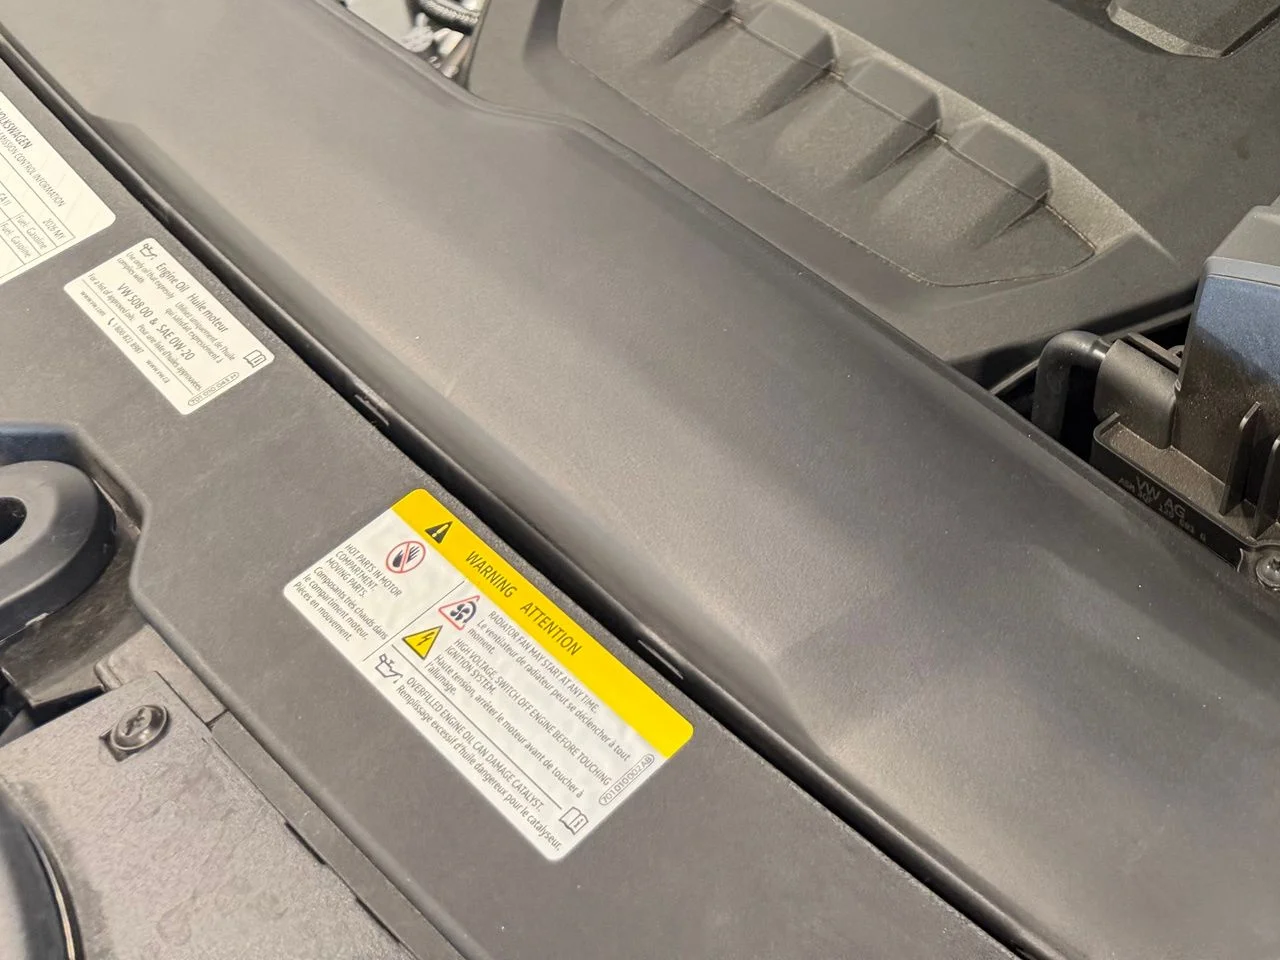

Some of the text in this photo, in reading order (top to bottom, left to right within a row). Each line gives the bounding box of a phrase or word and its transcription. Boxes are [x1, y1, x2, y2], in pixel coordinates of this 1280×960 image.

[155, 263, 190, 292] Engine Oil
[117, 283, 195, 360] VW 508 00 & SAE 0W-20
[187, 293, 228, 332] Huile moteur
[1136, 476, 1186, 518] VW AG
[302, 573, 311, 582] le
[309, 581, 348, 618] compartiment
[326, 558, 367, 597] MOVING PARTS.
[336, 551, 377, 590] COMPARTMENT.
[344, 544, 402, 596] HOT PARTS IN MOTOR
[309, 599, 319, 608] en
[313, 567, 346, 599] Composants
[354, 607, 375, 627] chauds
[372, 625, 388, 639] dans
[466, 551, 581, 654] WARNING ATTENTION
[445, 646, 496, 694] IGNITION SYSTEM.
[477, 619, 487, 630] Le
[485, 628, 518, 657] ventilateur
[515, 656, 526, 666] de
[524, 664, 553, 690] radiateur
[550, 689, 569, 705] peut
[566, 702, 576, 712] se
[575, 710, 610, 742] déclencher
[613, 745, 630, 761] tout
[488, 611, 599, 713] RADIATOR FAN MAY START AT ANY TIME.
[434, 654, 454, 674] Haute
[451, 672, 475, 697] tension,
[474, 695, 498, 716] arrêter
[495, 712, 504, 723] le
[502, 721, 527, 743] moteur
[524, 742, 545, 761] avant
[542, 759, 553, 770] de
[552, 767, 578, 792] toucher
[454, 638, 472, 655] HIGH
[495, 676, 520, 700] SWITCH
[517, 697, 533, 711] OFF
[529, 709, 555, 733] ENGINE
[552, 730, 579, 756] BEFORE
[577, 752, 611, 785] TOUCHING
[396, 685, 561, 850] Remplissage excessif d'huile dangereux pour le catalyseur.
[407, 677, 544, 811] OVERFILLED ENGINE OIL CAN DAMAGE CATALYST.
